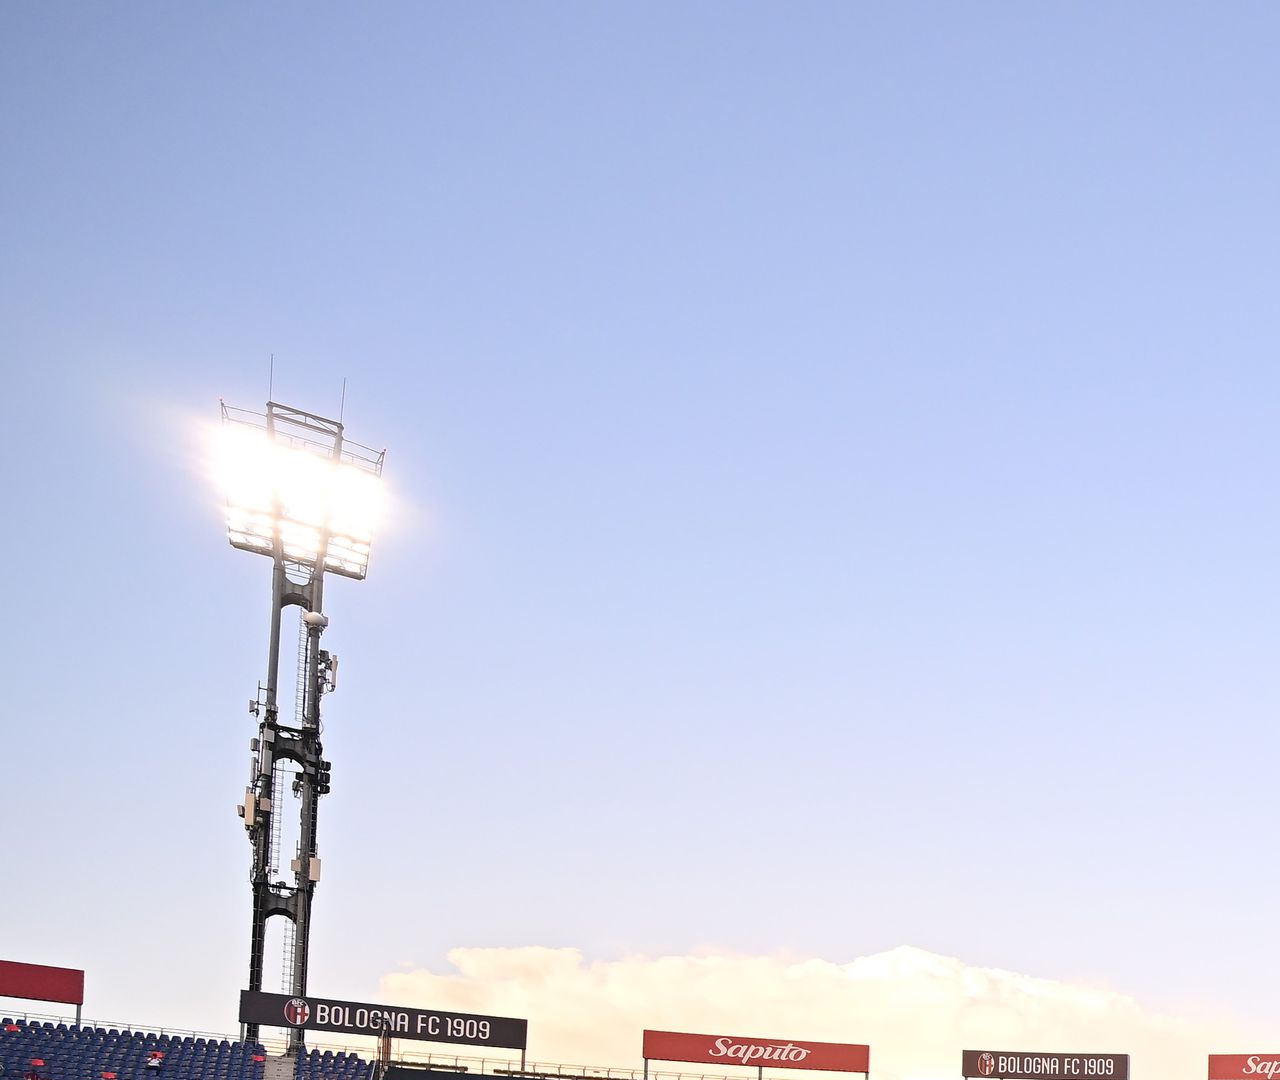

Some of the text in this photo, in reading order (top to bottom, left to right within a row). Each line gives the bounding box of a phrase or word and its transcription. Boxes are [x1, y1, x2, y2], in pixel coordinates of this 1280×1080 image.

[316, 1004, 490, 1040] BOLOGNA FC 1909
[708, 1038, 811, 1064] Saputo
[998, 1056, 1059, 1074] BOLOGNA
[1064, 1058, 1080, 1074] FC
[1083, 1058, 1113, 1075] 1909
